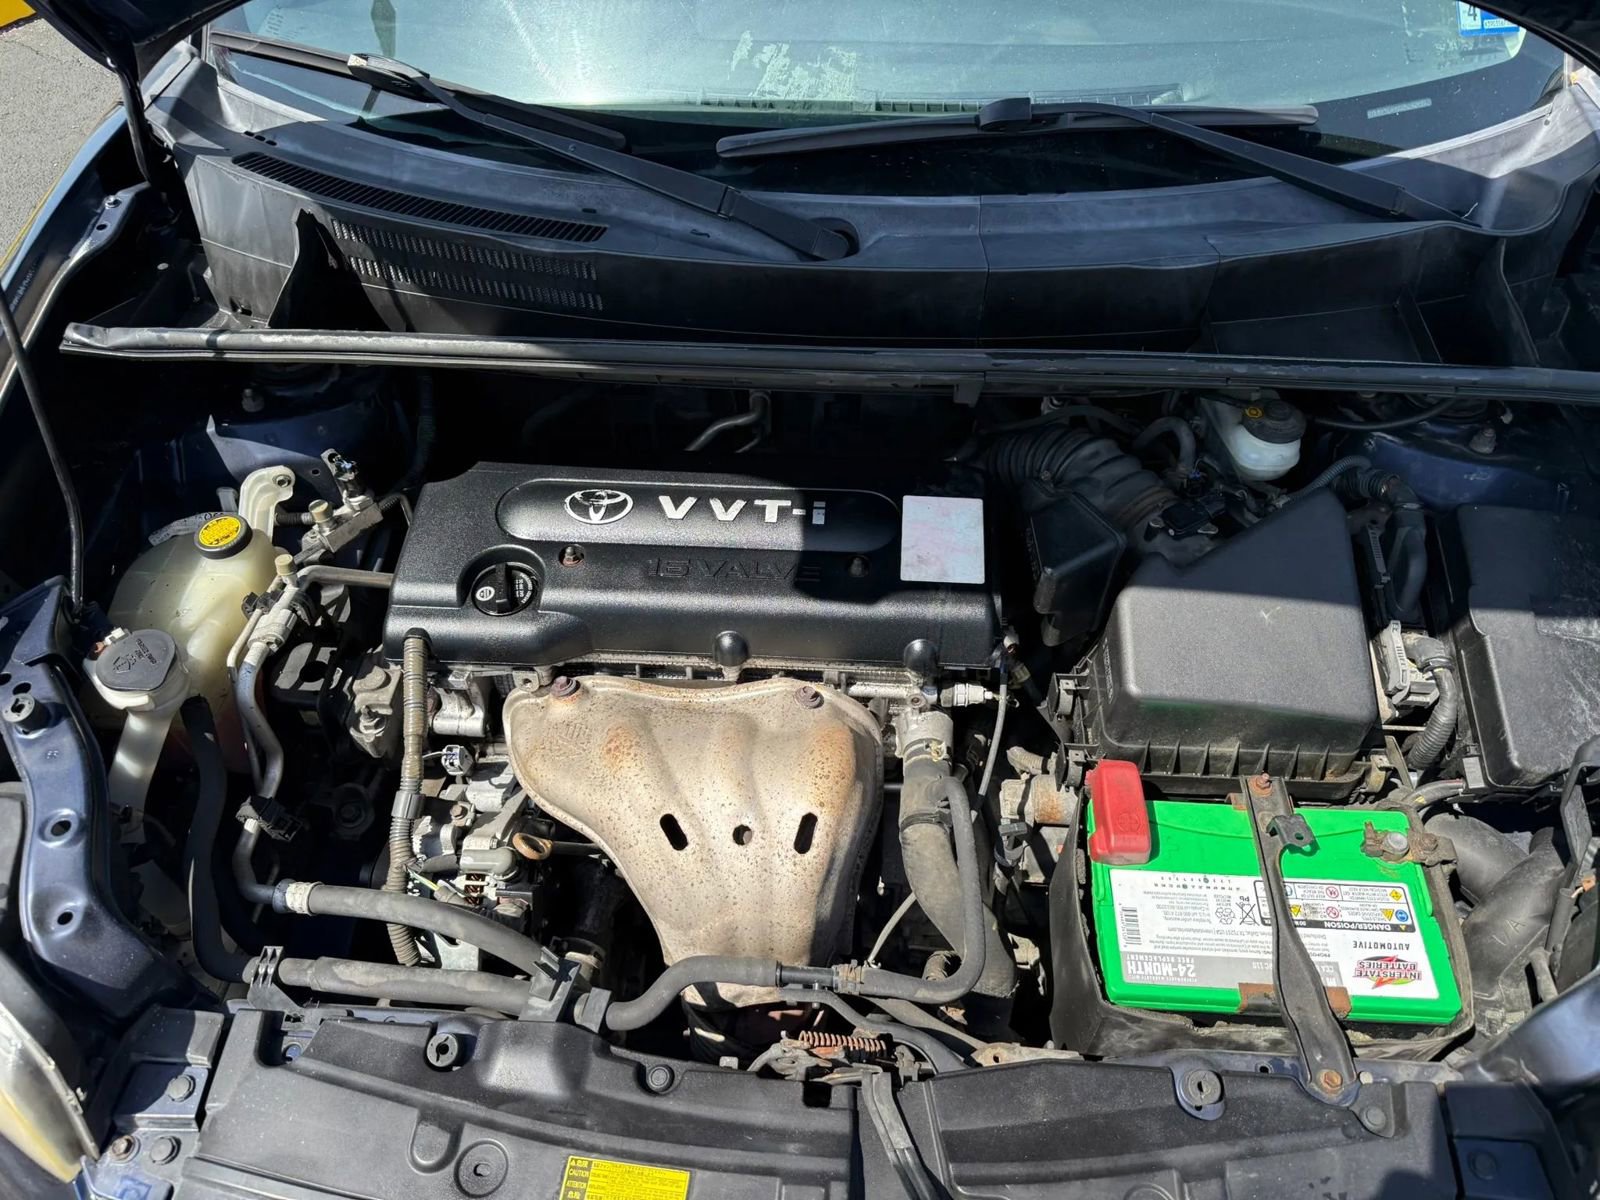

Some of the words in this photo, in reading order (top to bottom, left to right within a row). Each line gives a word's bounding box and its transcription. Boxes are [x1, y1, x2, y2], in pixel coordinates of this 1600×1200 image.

[658, 495, 826, 526] VVT-i
[649, 558, 691, 578] 16
[1324, 921, 1390, 930] DANGER/POISON
[1353, 941, 1410, 950] AUTOMOTIVE
[1126, 954, 1174, 962] REPLACEMENT
[1127, 961, 1196, 977] 24-MONTH
[1358, 961, 1417, 970] BATTERIES
[1356, 970, 1420, 979] INTERSTATE
[568, 1168, 590, 1178] CAUTION
